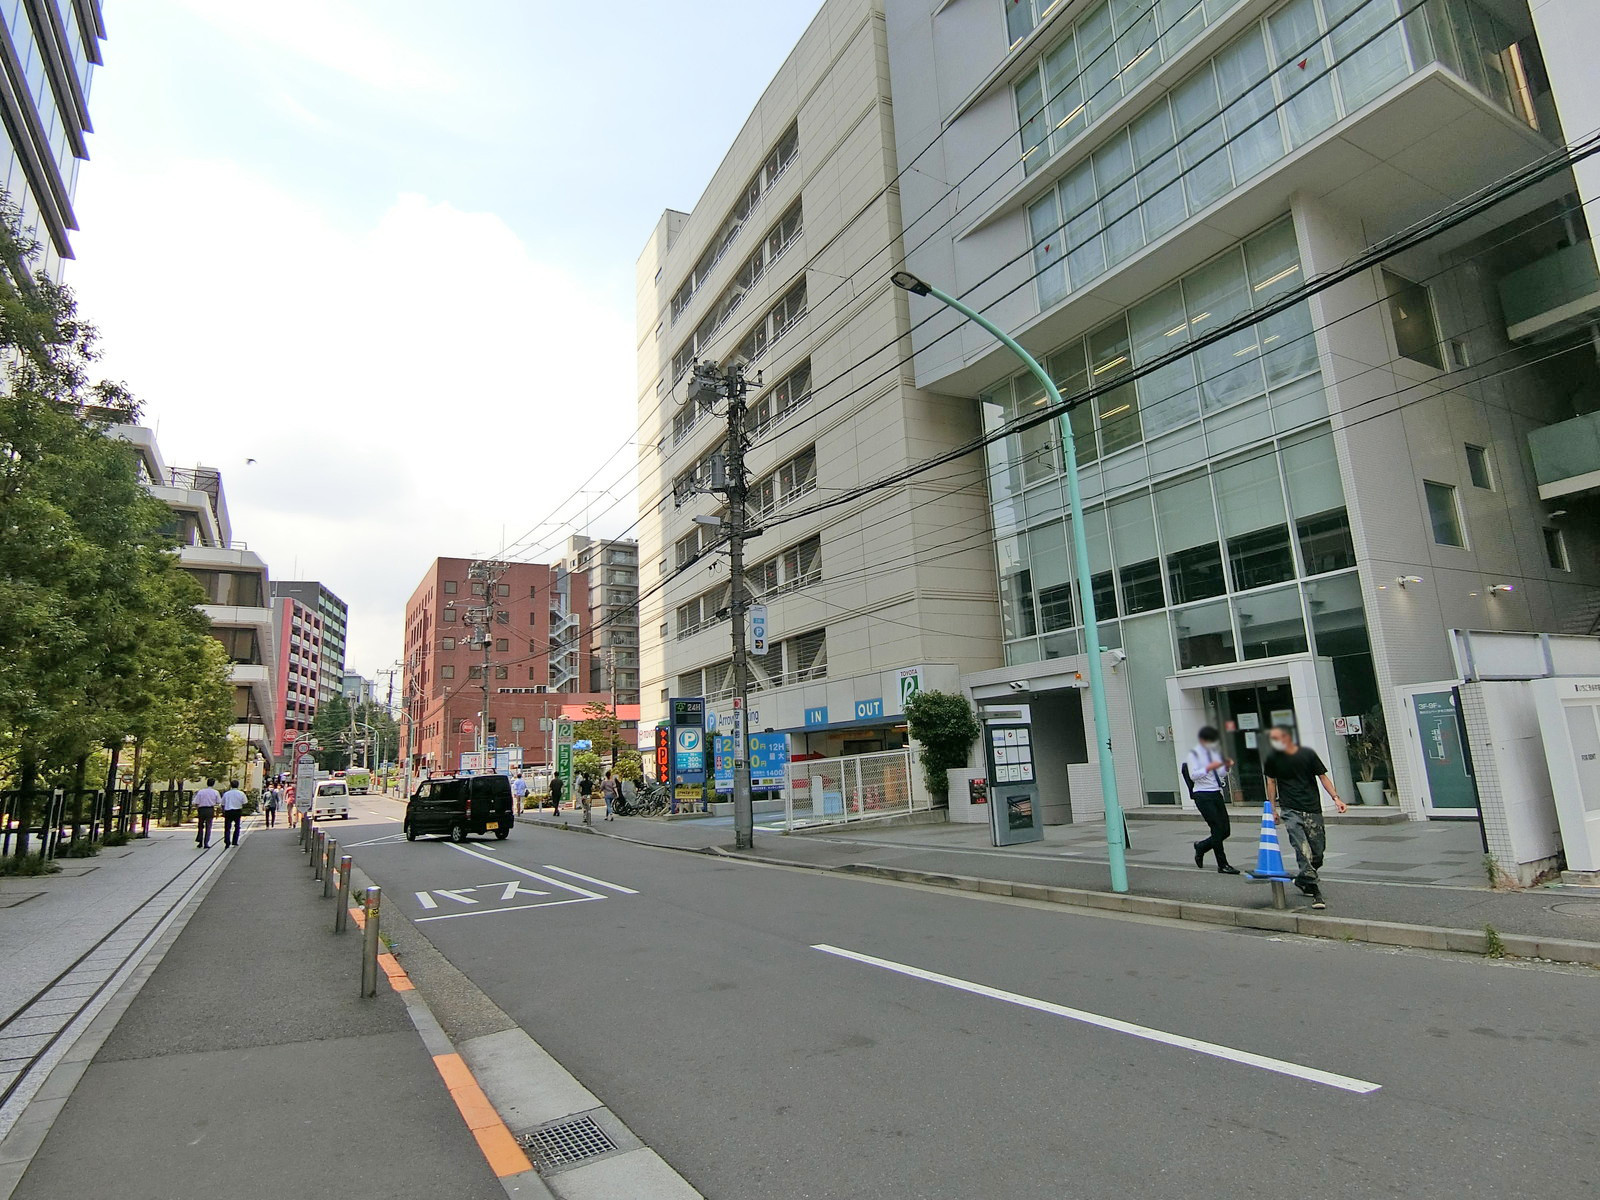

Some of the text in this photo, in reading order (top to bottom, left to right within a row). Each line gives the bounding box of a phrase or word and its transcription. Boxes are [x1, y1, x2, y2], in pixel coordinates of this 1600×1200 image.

[900, 668, 918, 676] TOYOTA
[687, 703, 701, 711] 24H
[857, 701, 880, 717] OUT
[811, 710, 822, 723] IN
[684, 732, 696, 747] P
[769, 743, 784, 751] 12H
